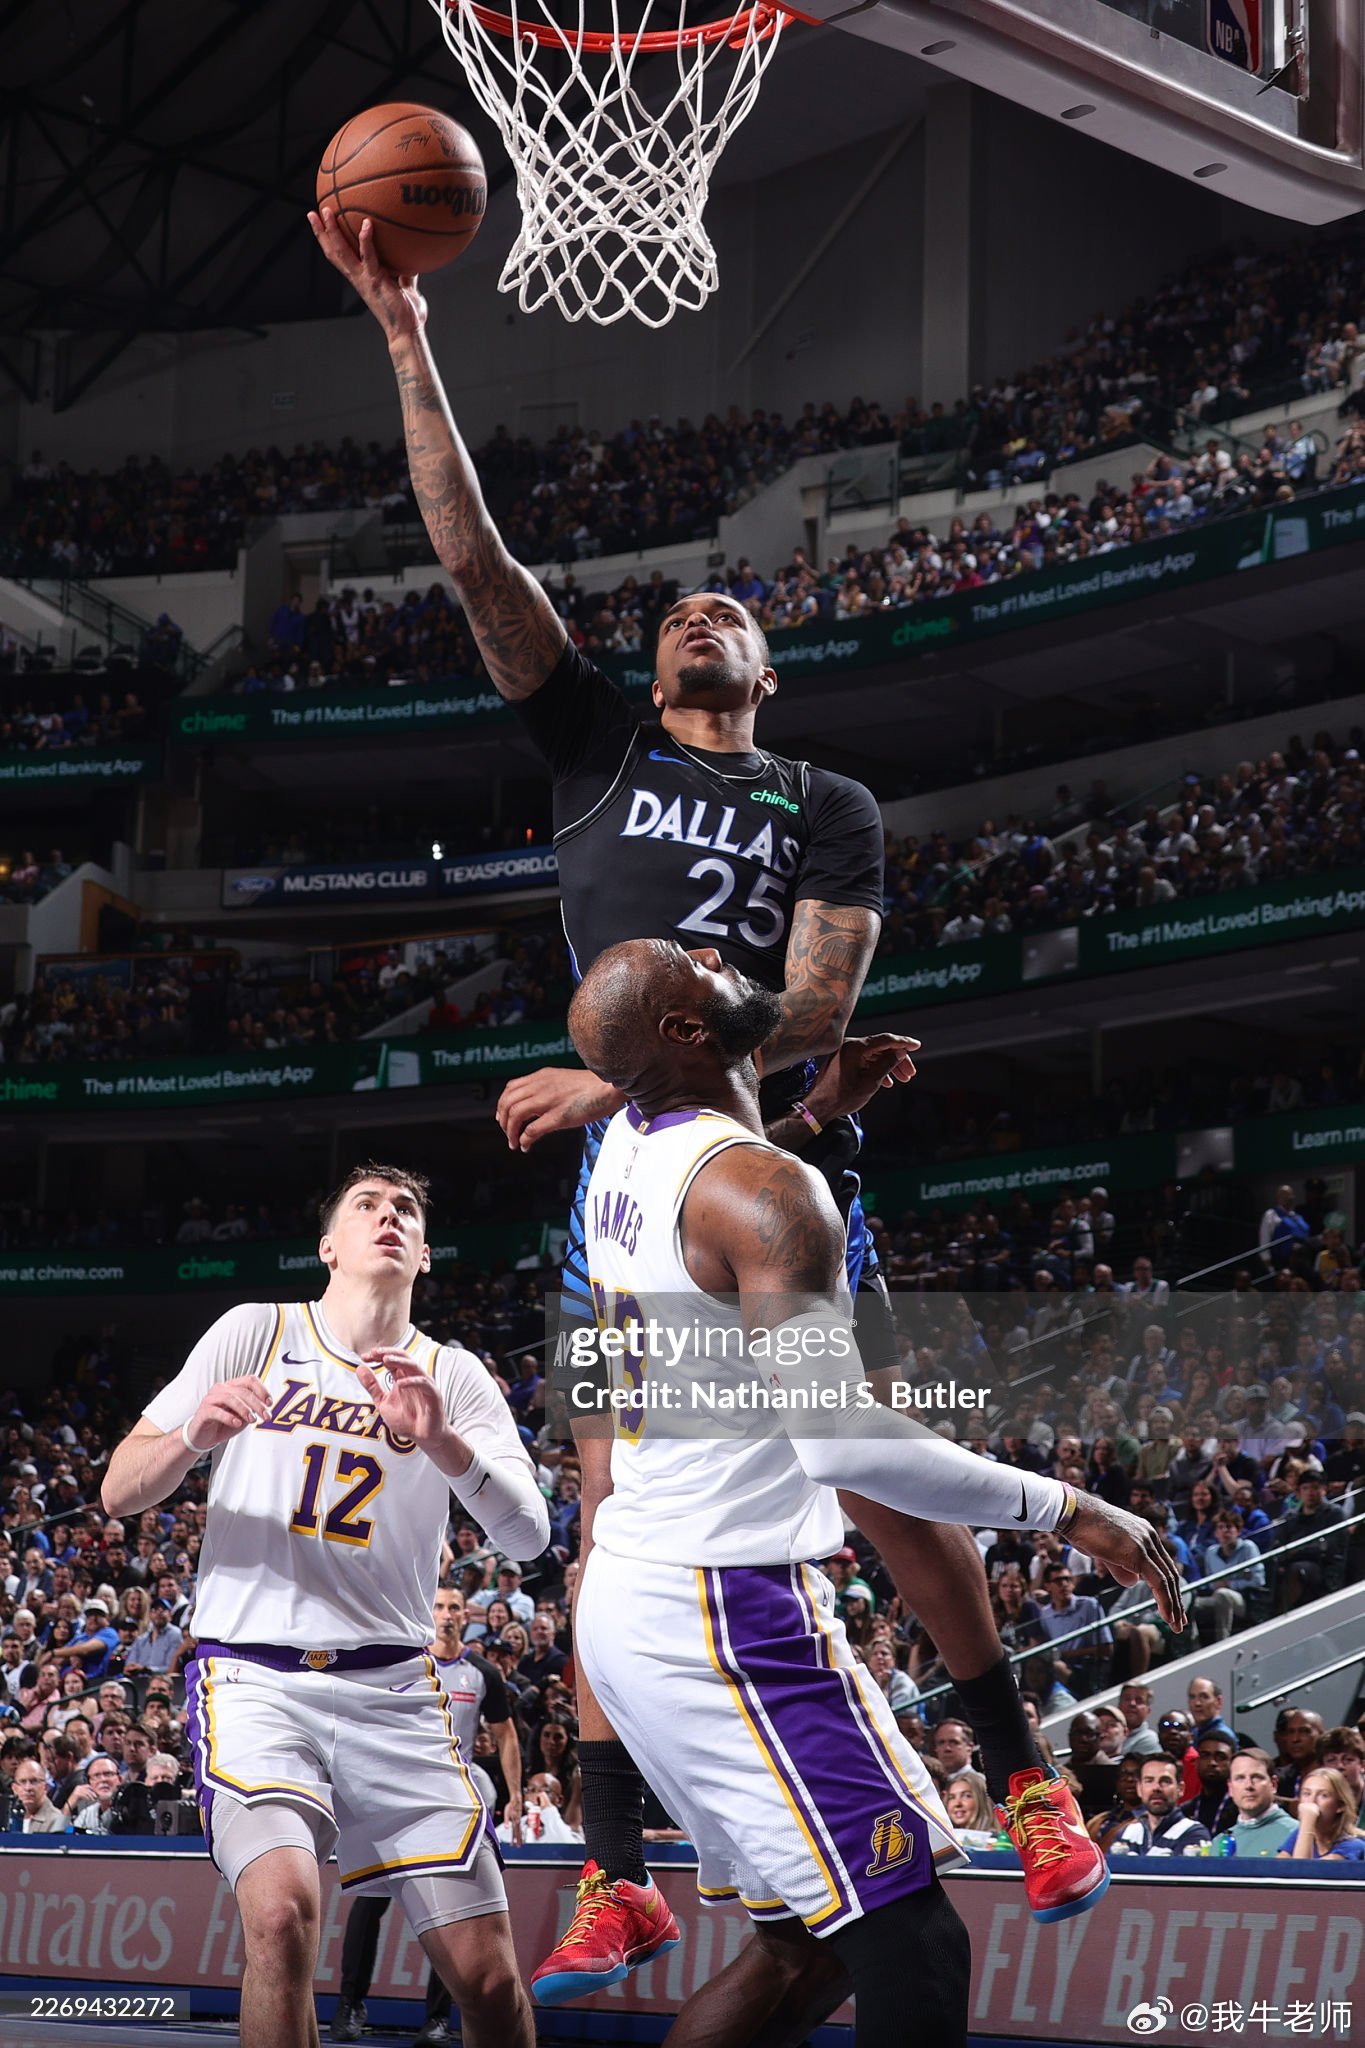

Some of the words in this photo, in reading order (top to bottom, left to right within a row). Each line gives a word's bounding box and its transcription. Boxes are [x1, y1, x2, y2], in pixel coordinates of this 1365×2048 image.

[1321, 508, 1353, 528] The
[972, 604, 998, 622] The
[1000, 598, 1018, 616] #1
[1019, 588, 1056, 612] Most
[1058, 575, 1099, 599] Loved
[1102, 558, 1162, 592] Banking
[1163, 550, 1196, 574] App
[892, 615, 955, 646] chime
[825, 639, 860, 657] App
[180, 708, 247, 734] chime
[271, 708, 300, 725] The
[303, 707, 322, 723] #1
[323, 704, 365, 723] Most
[367, 701, 412, 721] Loved
[415, 694, 475, 718] Banking
[17, 762, 57, 778] Loved
[59, 760, 112, 777] Banking
[113, 758, 143, 775] App
[750, 789, 799, 813] chime
[619, 788, 800, 878] DALLAS
[283, 871, 375, 892] MUSTANG
[378, 870, 428, 887] CLUB
[675, 857, 787, 948] 25
[1107, 932, 1139, 951] The
[1141, 926, 1161, 945] #1
[1163, 920, 1207, 942] Most
[1208, 906, 1259, 934] Loved
[1261, 894, 1334, 922] Banking
[887, 967, 948, 993] Banking
[949, 961, 983, 984] App
[433, 1049, 462, 1068] The
[463, 1045, 482, 1064] #1
[483, 1043, 522, 1063] Most
[523, 1036, 565, 1059] Loved
[83, 1077, 114, 1096] The
[116, 1076, 136, 1094] #1
[136, 1074, 177, 1094] Most
[178, 1070, 222, 1092] Loved
[223, 1065, 283, 1088] Banking
[282, 1064, 315, 1084] App
[1292, 1130, 1343, 1150] Learn
[920, 1181, 963, 1201] Learn
[963, 1175, 1005, 1194] more
[1005, 1170, 1022, 1189] at
[1023, 1160, 1111, 1187] chime.com
[592, 1190, 643, 1257] JAMES
[20, 1266, 36, 1281] at
[36, 1263, 125, 1281] chime.com
[178, 1256, 236, 1280] chime
[289, 1442, 385, 1549] 12
[0, 1869, 176, 1972] irates
[974, 1903, 1094, 2025] FLY
[1103, 1908, 1364, 2042] BETTER
